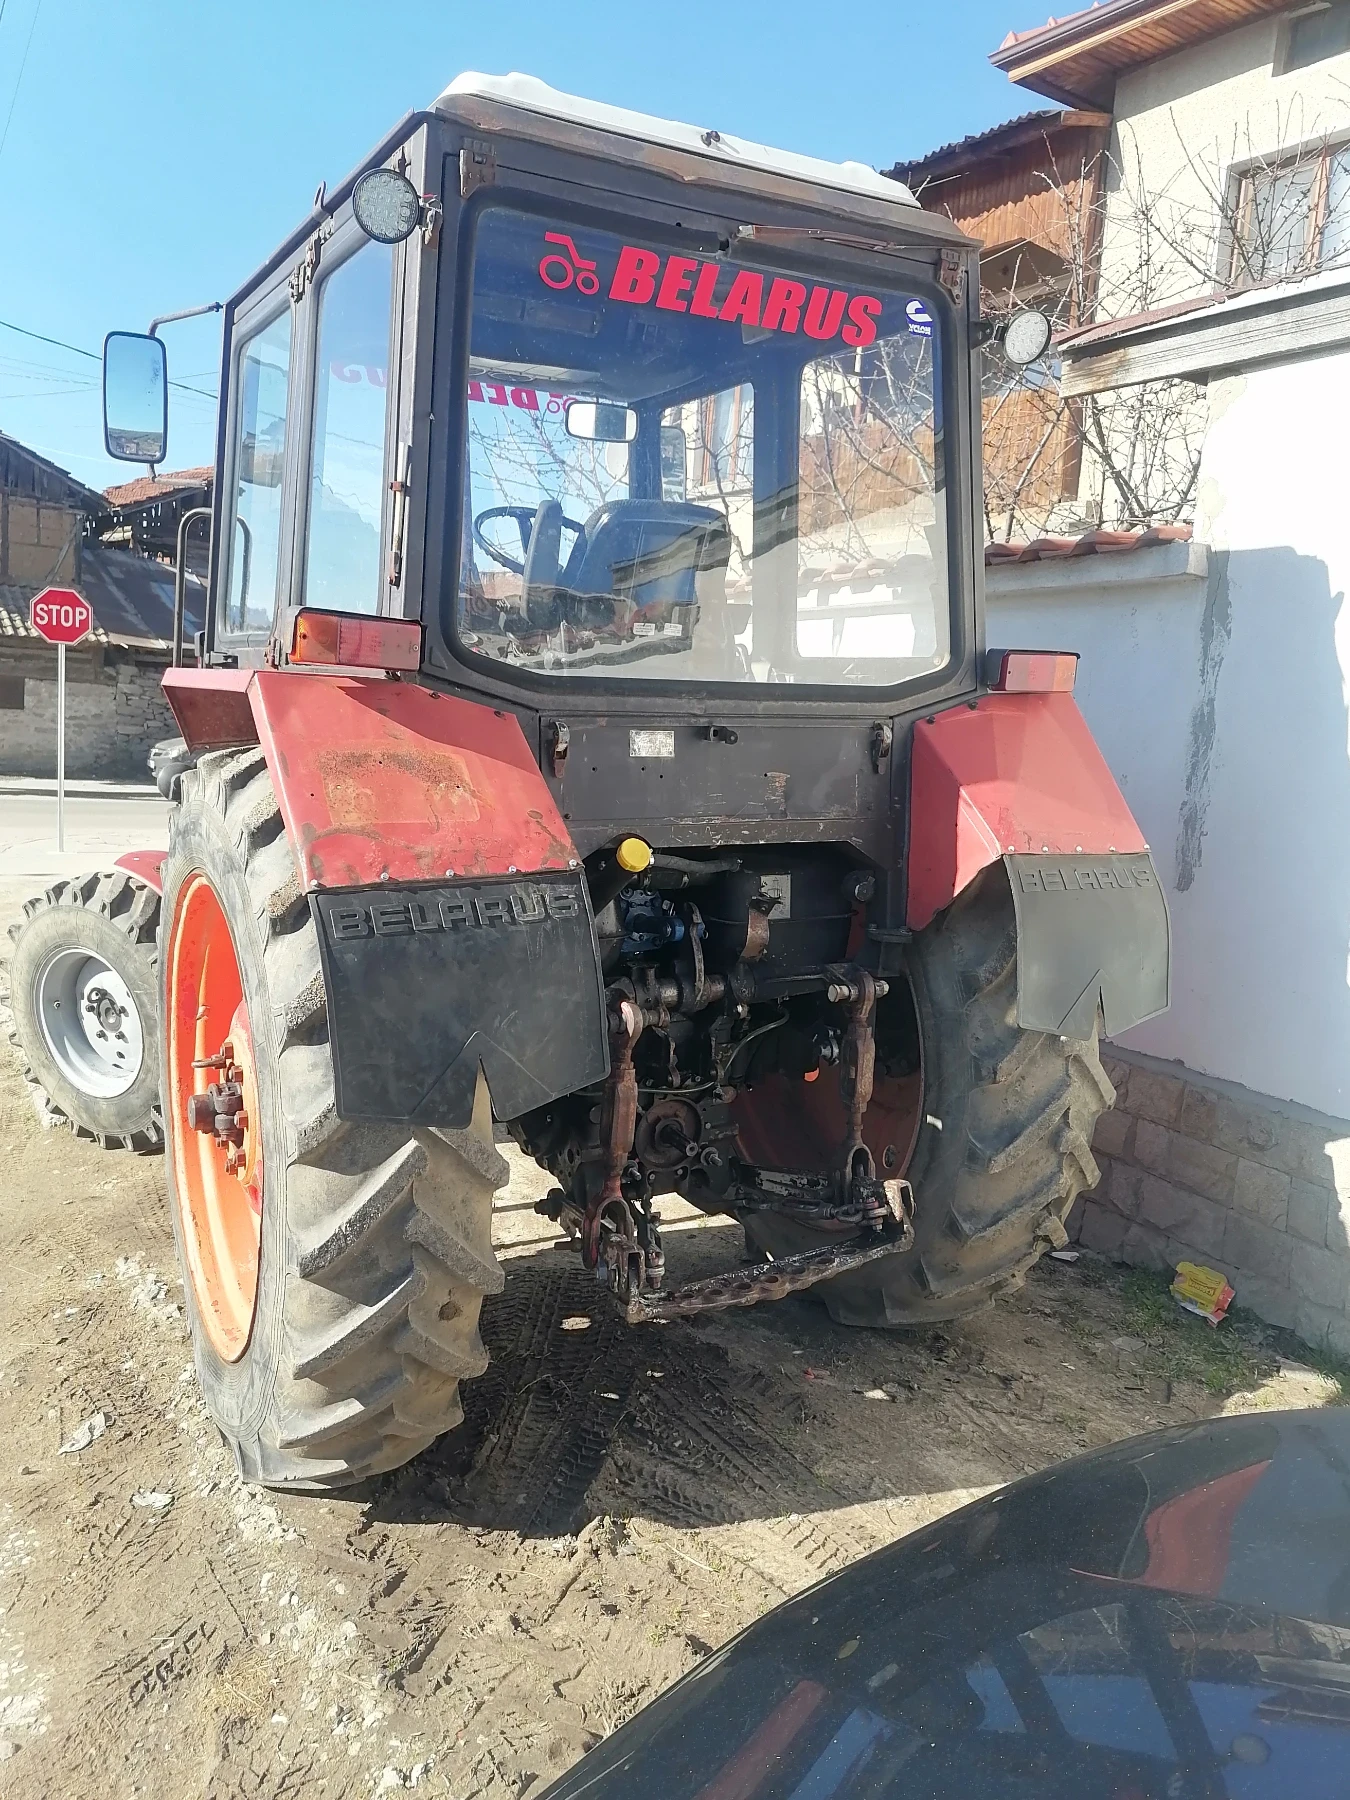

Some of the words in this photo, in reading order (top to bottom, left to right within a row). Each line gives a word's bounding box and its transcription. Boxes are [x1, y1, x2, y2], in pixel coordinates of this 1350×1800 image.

[609, 246, 882, 347] BELARUS
[36, 603, 87, 628] STOP
[1018, 865, 1154, 893] BELARUS
[329, 890, 580, 939] BELARUS
